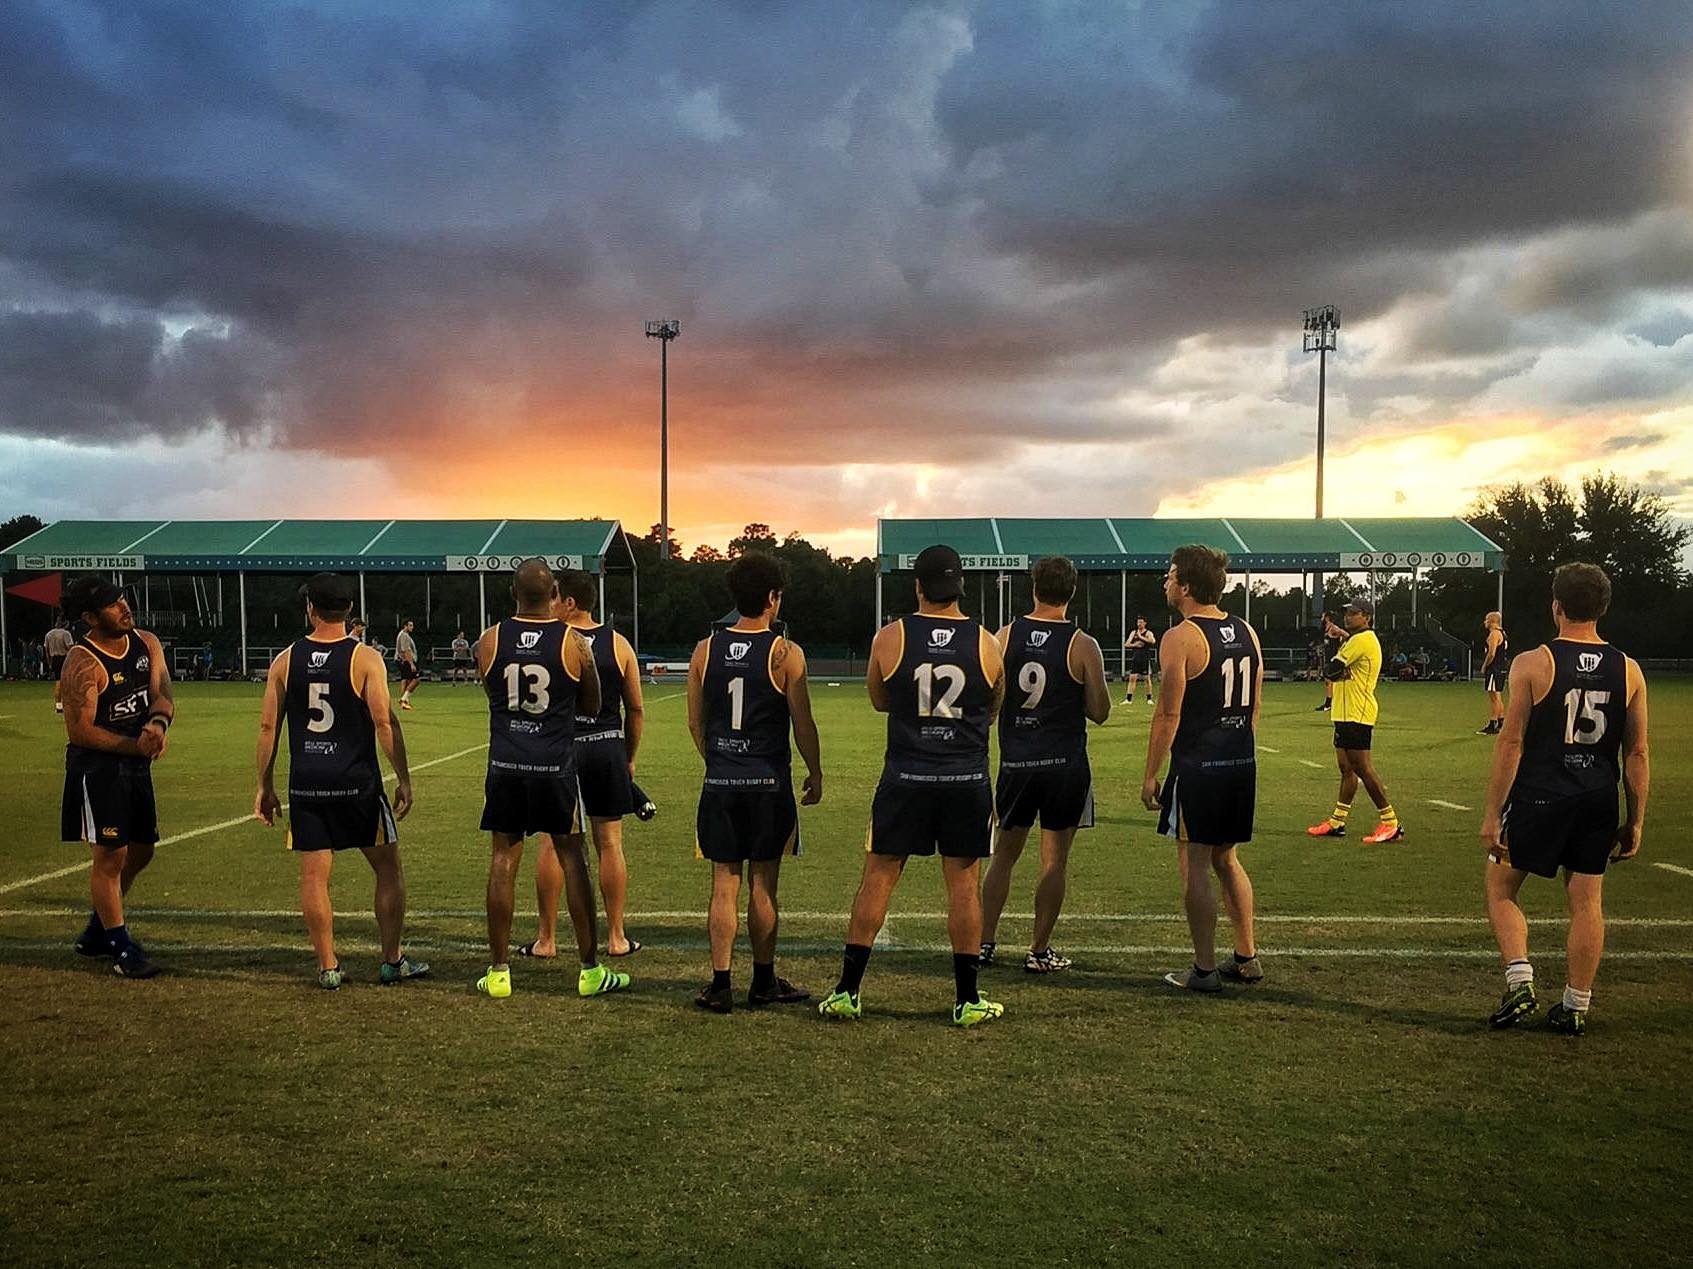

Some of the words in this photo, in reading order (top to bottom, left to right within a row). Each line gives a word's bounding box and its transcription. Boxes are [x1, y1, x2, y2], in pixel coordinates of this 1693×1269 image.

[50, 557, 92, 568] SPORTS
[96, 557, 137, 568] FIELDS
[979, 557, 1020, 567] FIELDS
[306, 682, 335, 733] 5
[503, 663, 550, 715] 13
[727, 676, 745, 731] 1
[913, 663, 966, 719] 12
[1018, 661, 1047, 710] 9
[1221, 656, 1251, 709] 11
[1564, 688, 1612, 745] 15
